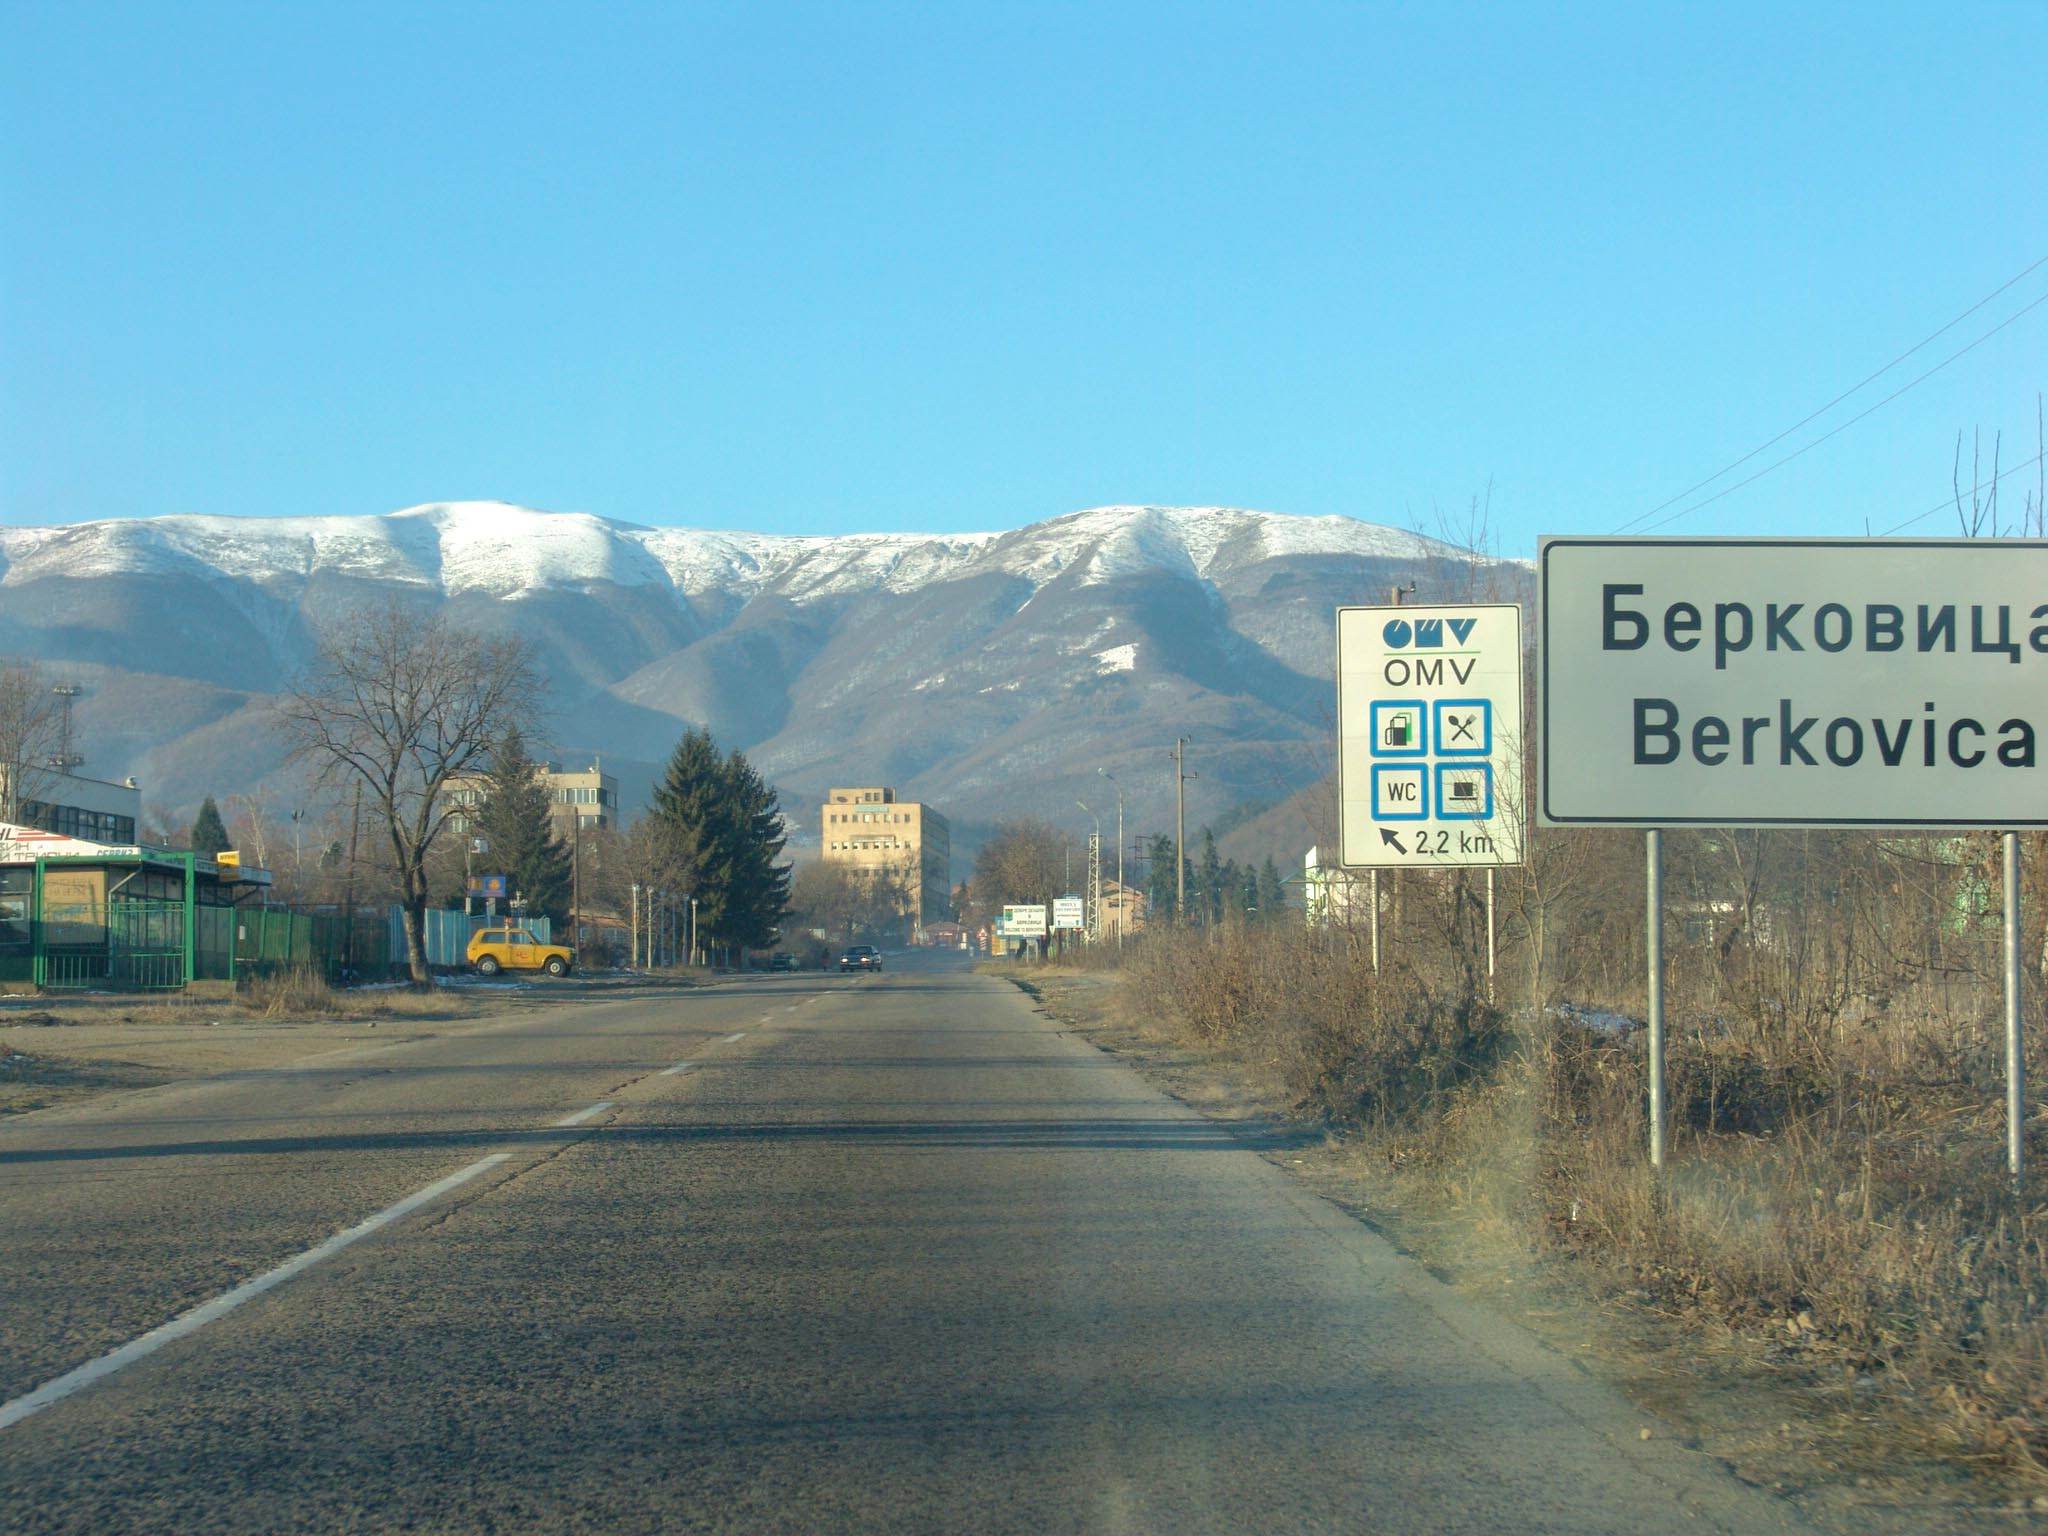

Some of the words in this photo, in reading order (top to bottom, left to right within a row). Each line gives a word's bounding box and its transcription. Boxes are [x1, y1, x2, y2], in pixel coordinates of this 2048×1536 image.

[1384, 658, 1476, 686] OMV
[1633, 697, 2036, 768] Berkovica
[1388, 782, 1416, 801] WC
[1415, 830, 1449, 856] 2,2
[1460, 831, 1494, 854] km
